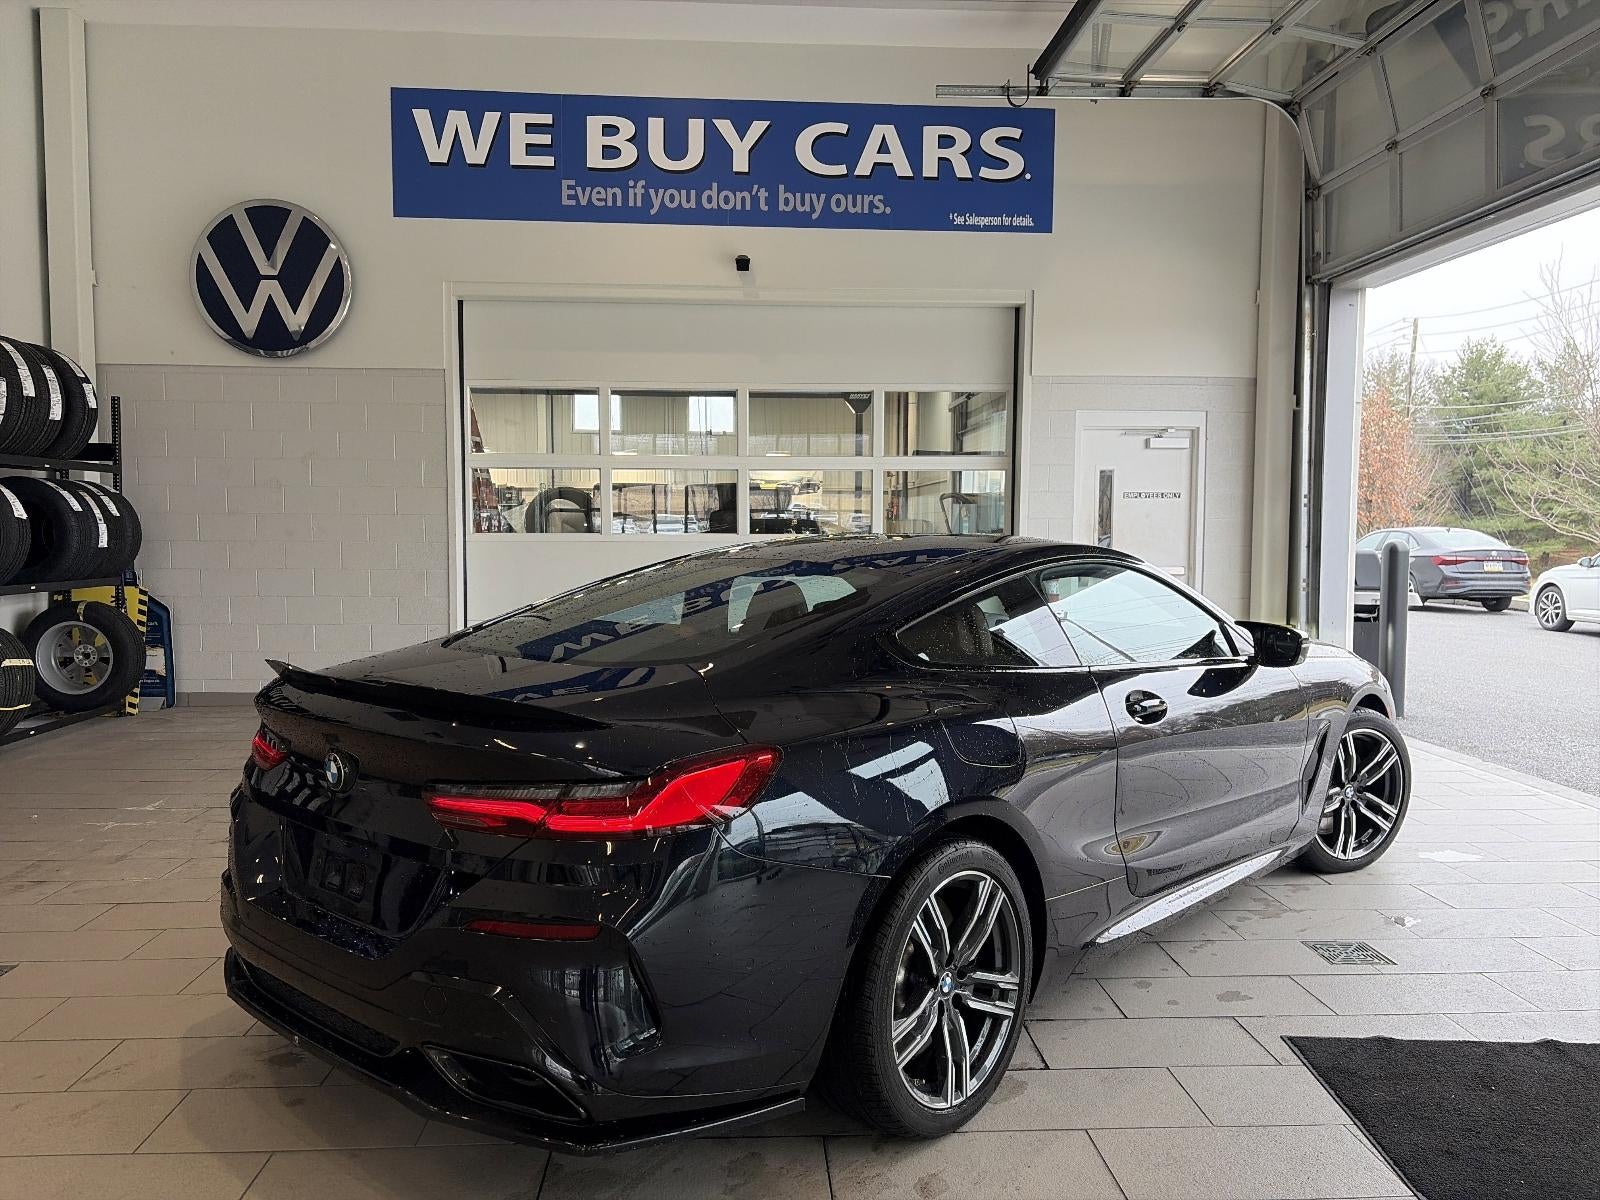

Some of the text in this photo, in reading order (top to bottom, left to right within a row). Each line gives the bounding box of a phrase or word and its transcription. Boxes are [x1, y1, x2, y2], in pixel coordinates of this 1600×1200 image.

[412, 108, 1032, 181] WE BUY CARS.
[561, 179, 892, 220] Even if you don’t buy ours.
[953, 213, 1035, 228] See Salesperson for details.
